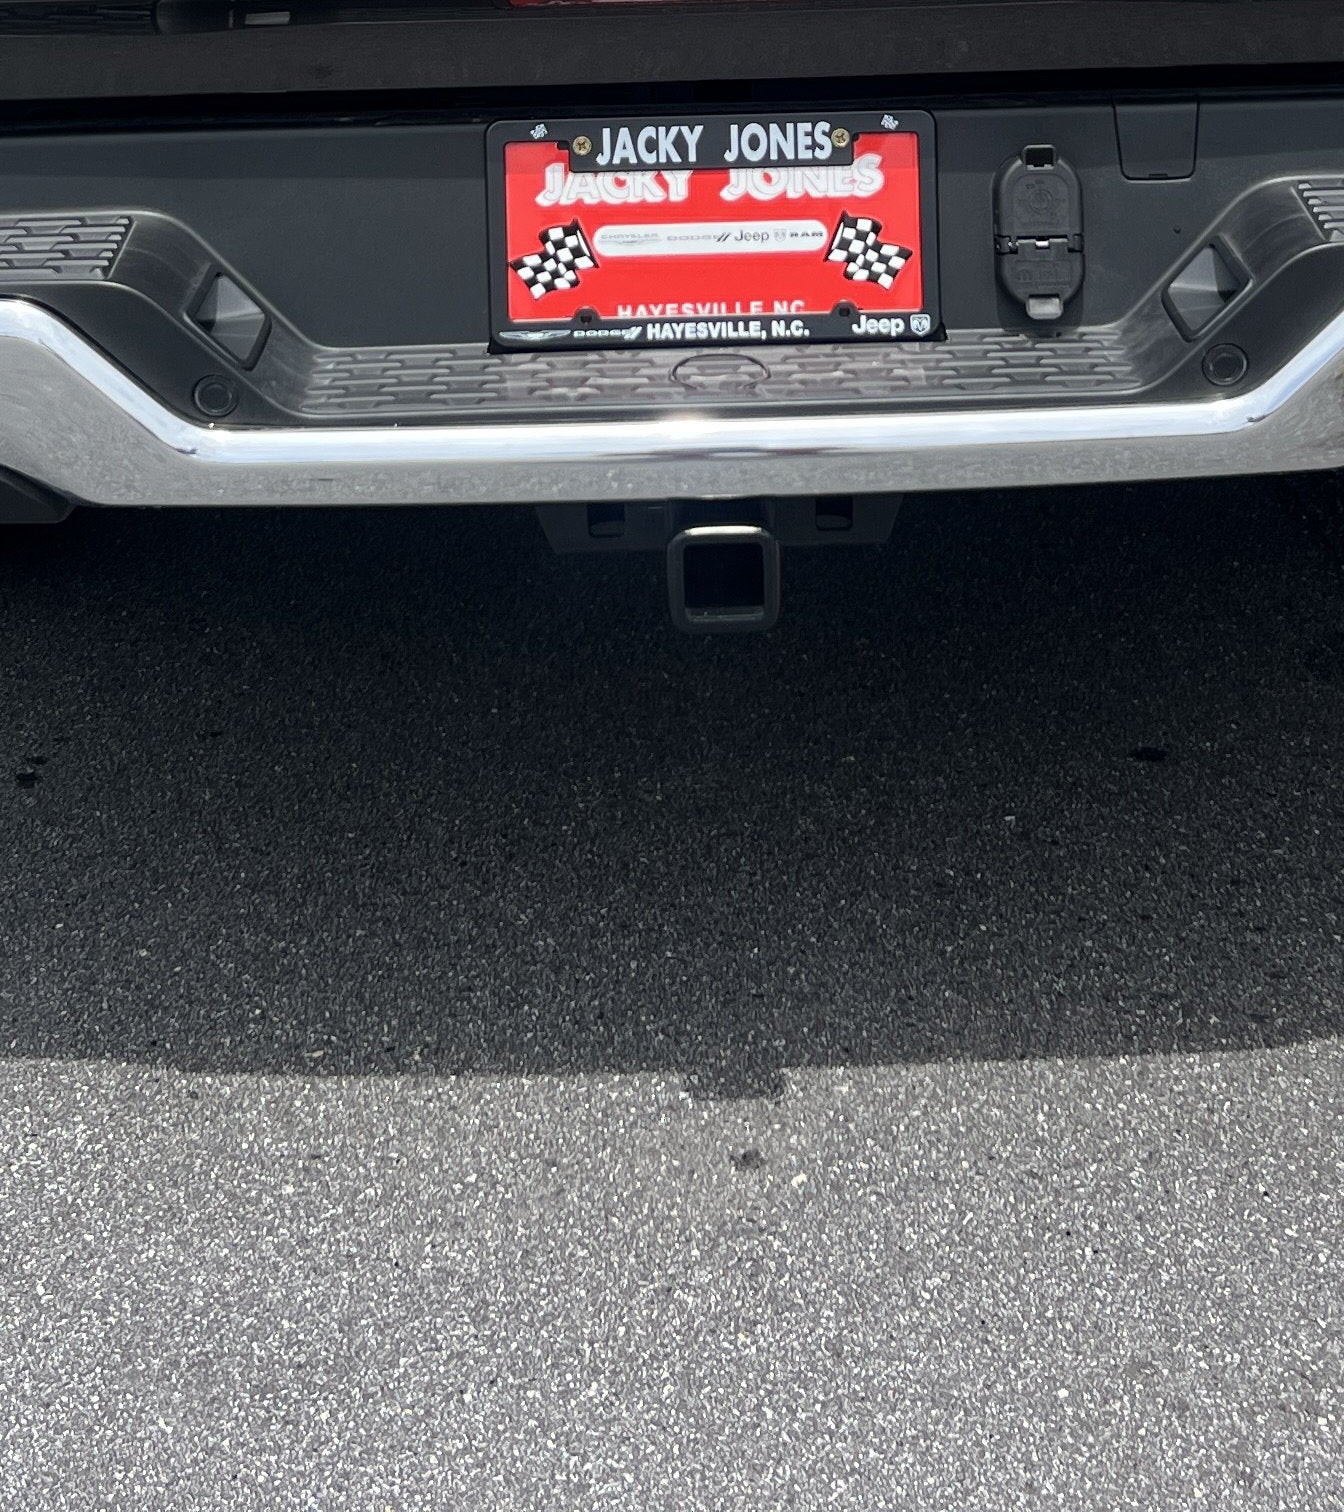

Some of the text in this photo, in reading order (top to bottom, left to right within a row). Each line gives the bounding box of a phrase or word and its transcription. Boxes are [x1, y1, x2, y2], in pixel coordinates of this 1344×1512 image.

[596, 121, 832, 166] JACKY JONES
[535, 153, 885, 207] JACKY JONES
[734, 229, 770, 243] Jeep
[617, 299, 806, 319] HAYESVILLE NC
[646, 319, 767, 340] HAYESVILLE,
[771, 319, 811, 338] N.C.
[851, 314, 906, 337] Jeep
